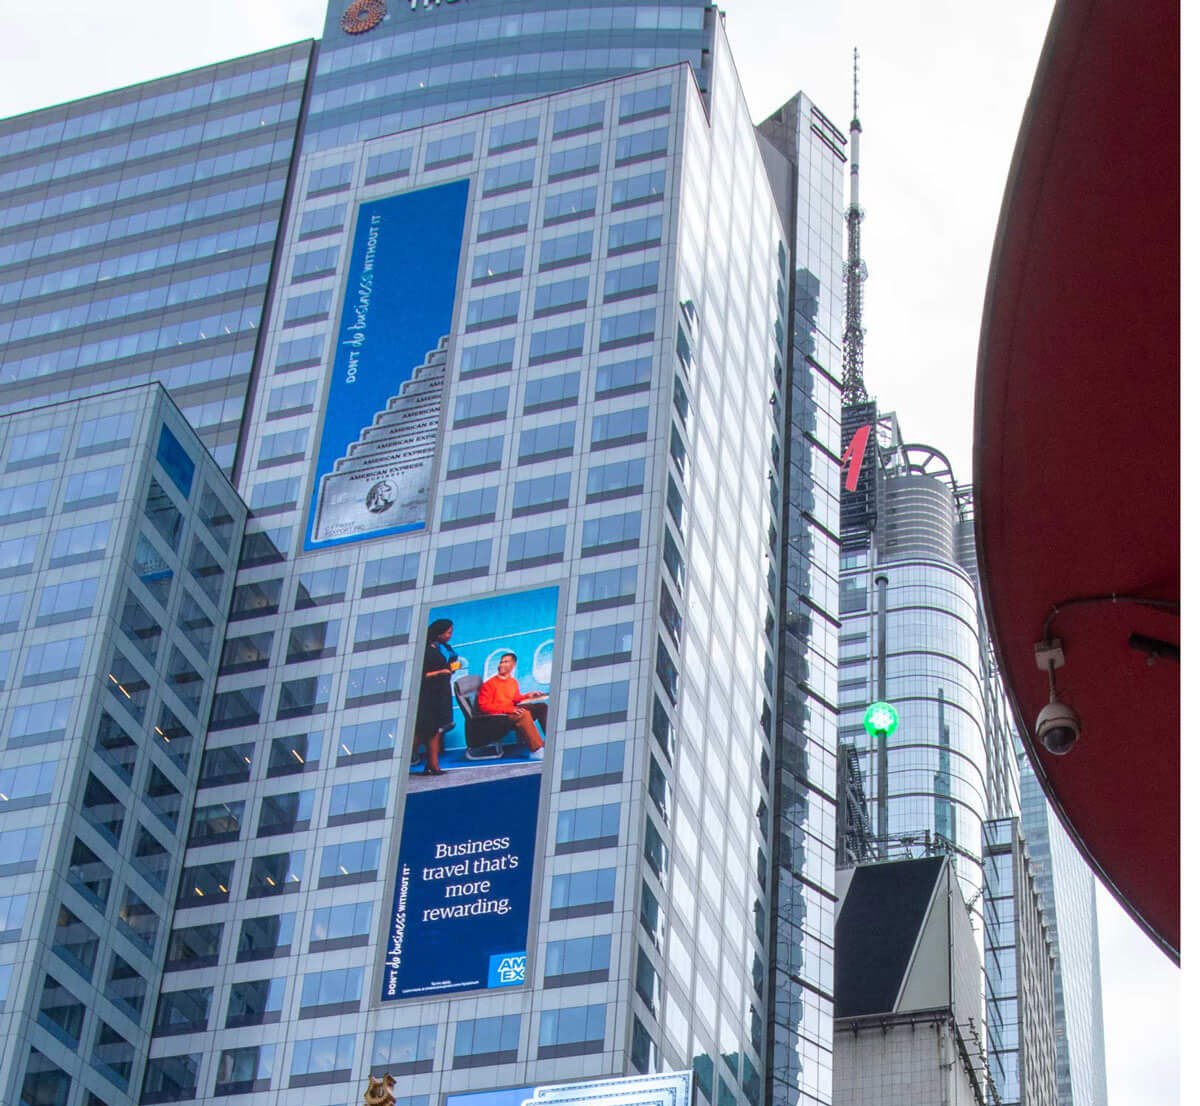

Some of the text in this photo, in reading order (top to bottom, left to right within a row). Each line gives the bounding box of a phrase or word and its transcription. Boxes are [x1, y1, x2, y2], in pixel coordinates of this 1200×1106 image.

[371, 215, 381, 224] IT
[364, 227, 379, 270] WITHOUT
[347, 269, 374, 330] business
[342, 332, 365, 347] do
[350, 470, 387, 481] AMERICAN
[434, 837, 511, 859] Business
[403, 867, 410, 875] IT
[422, 854, 519, 881] travel that's
[399, 877, 409, 912] WITHOUT
[444, 880, 490, 898] more
[422, 898, 512, 922] rewarding.
[388, 912, 406, 955] business
[385, 957, 400, 968] do
[498, 955, 526, 972] AM
[501, 970, 525, 983] EX
